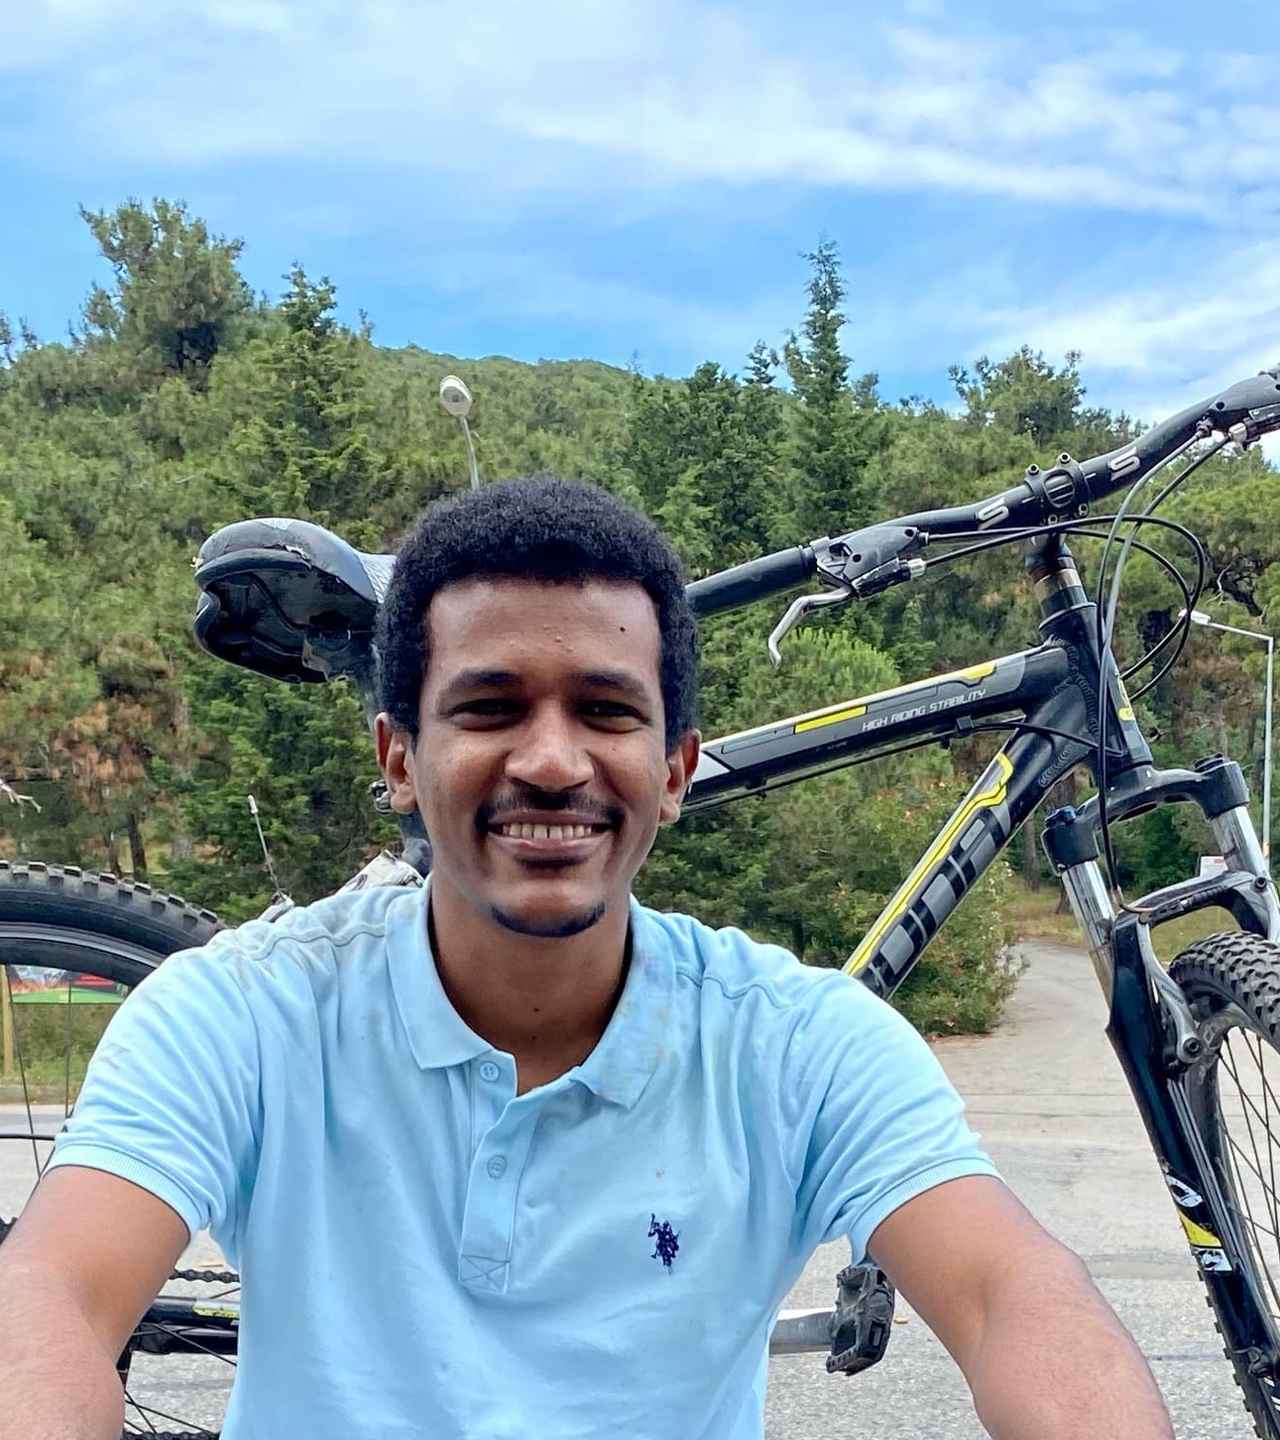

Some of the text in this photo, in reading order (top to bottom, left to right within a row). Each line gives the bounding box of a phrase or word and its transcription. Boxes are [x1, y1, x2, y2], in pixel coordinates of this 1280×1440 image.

[862, 688, 986, 732] HIGH RIDING STABILITY
